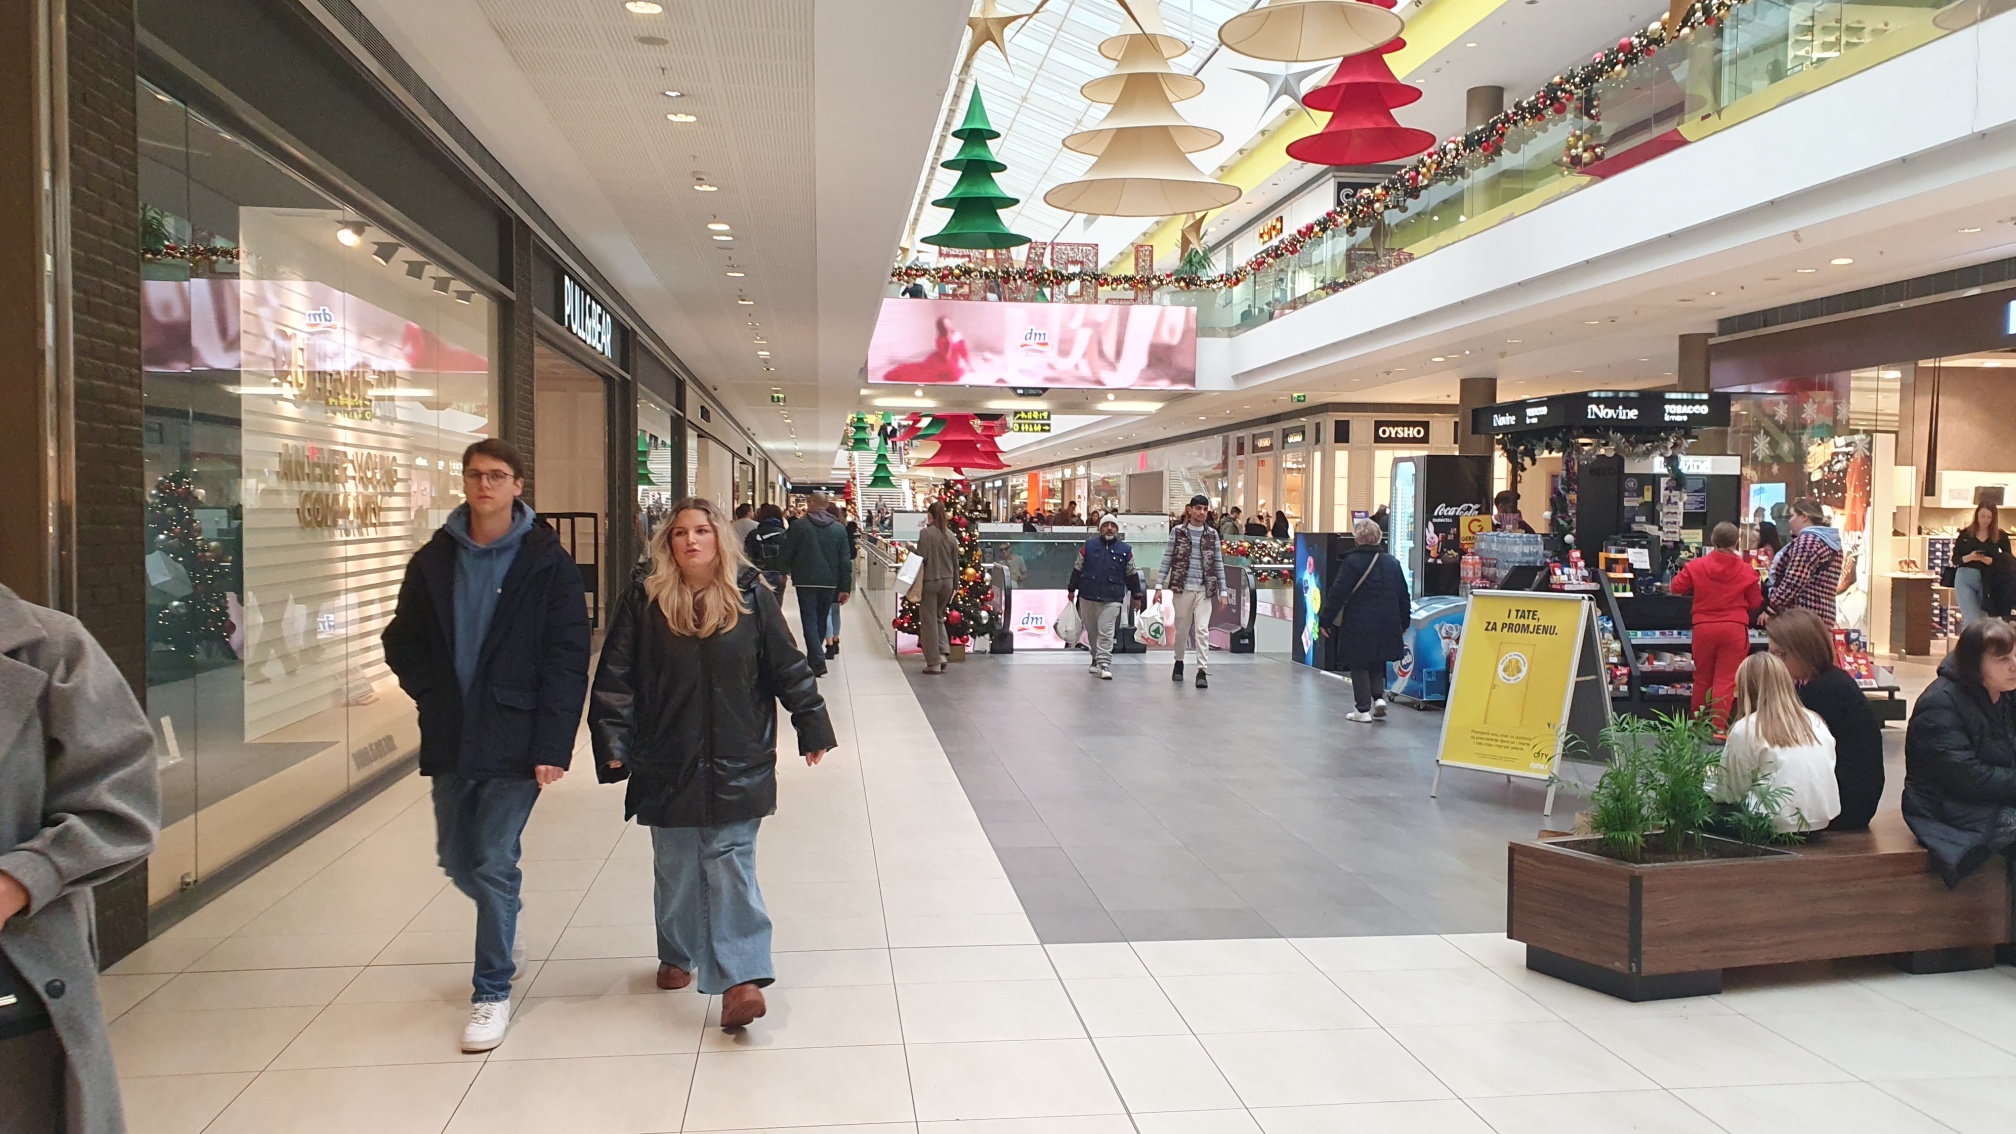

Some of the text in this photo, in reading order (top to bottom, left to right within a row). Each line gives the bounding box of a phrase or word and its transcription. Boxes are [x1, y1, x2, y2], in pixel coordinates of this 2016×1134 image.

[564, 274, 612, 359] PULL&BEAR
[1024, 327, 1047, 342] dm
[1587, 403, 1709, 420] iNovine TOBACCO
[1378, 426, 1425, 438] OYSHO
[1021, 612, 1043, 627] dm
[1507, 608, 1541, 623] I TATE,
[1484, 621, 1559, 636] ZA PROMJENU.
